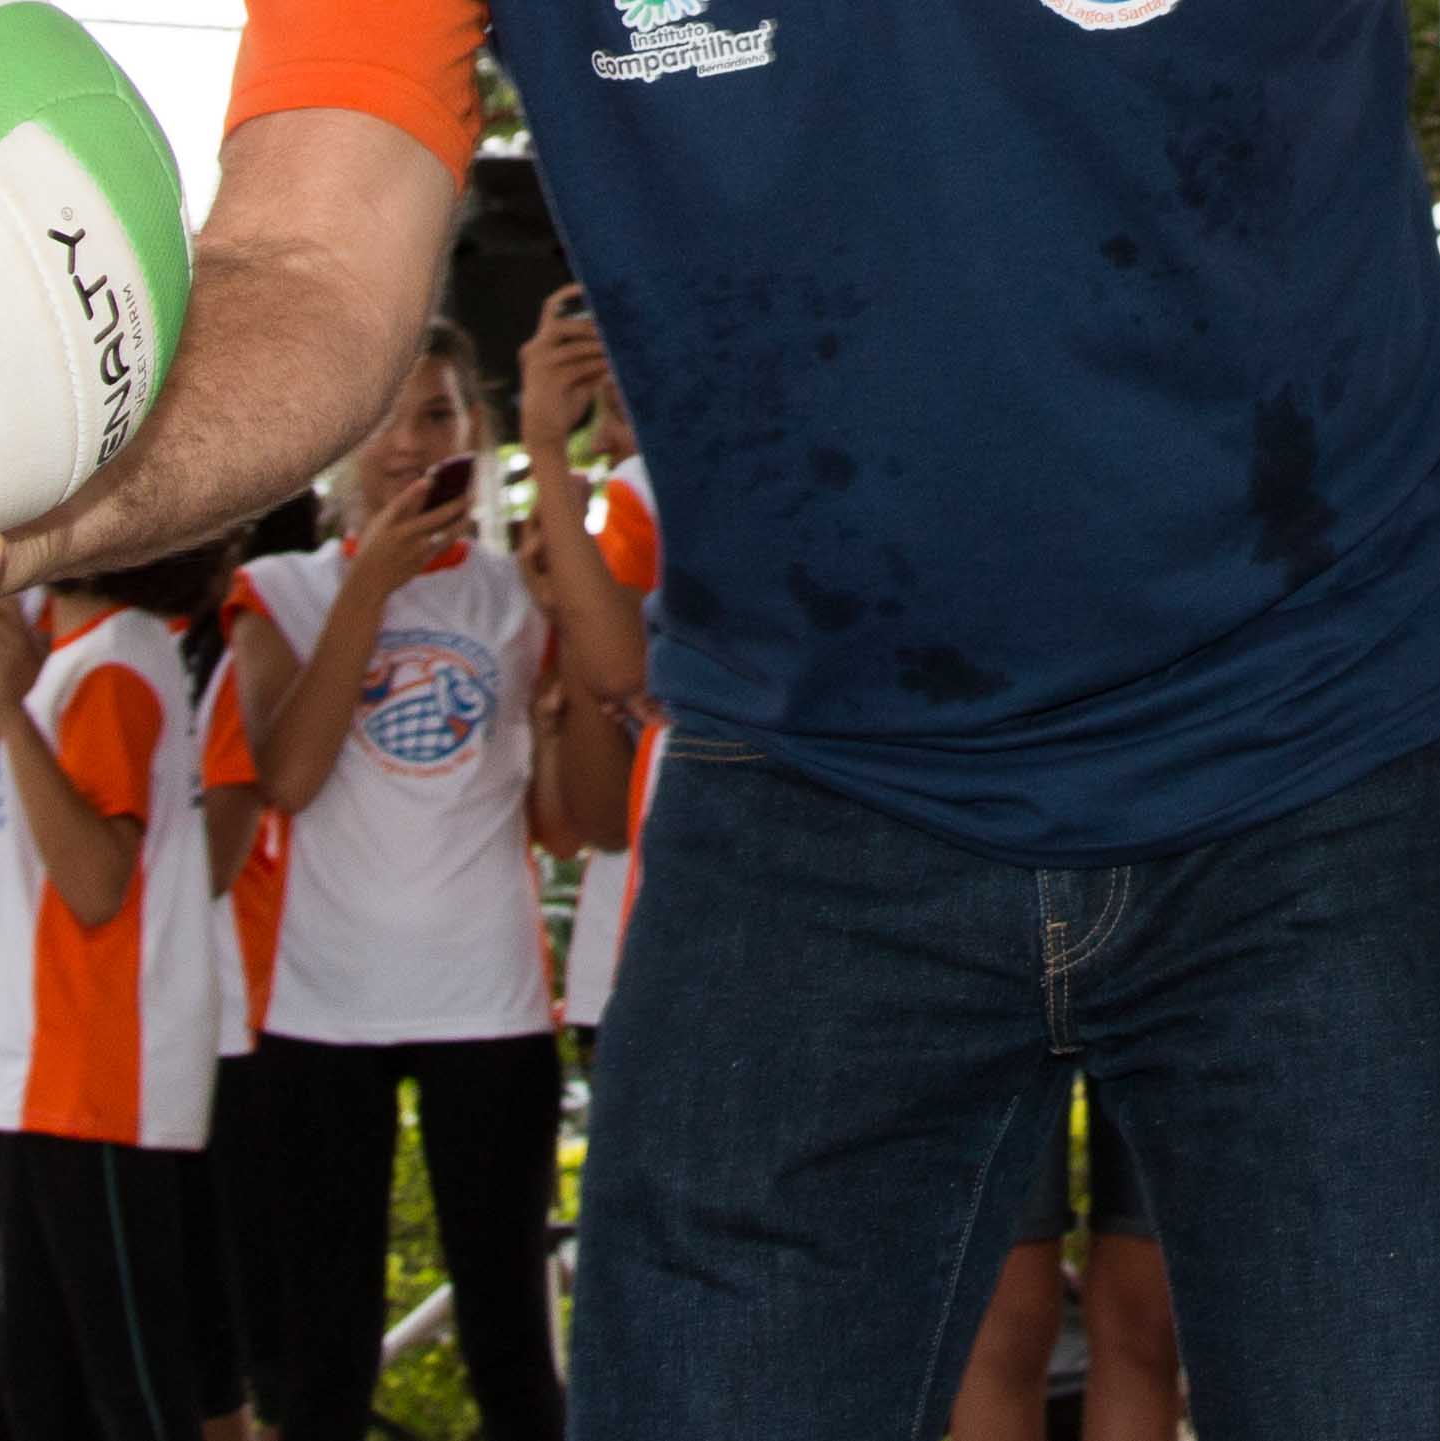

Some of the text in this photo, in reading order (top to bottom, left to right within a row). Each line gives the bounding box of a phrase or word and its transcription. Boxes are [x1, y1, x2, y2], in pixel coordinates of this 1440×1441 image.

[1066, 2, 1114, 24] Lagoa
[632, 23, 704, 49] Instituto
[593, 31, 763, 78] Compartilhar
[698, 53, 767, 75] Bernardinho
[122, 282, 145, 351] MIRIM
[47, 227, 132, 469] ENALTY
